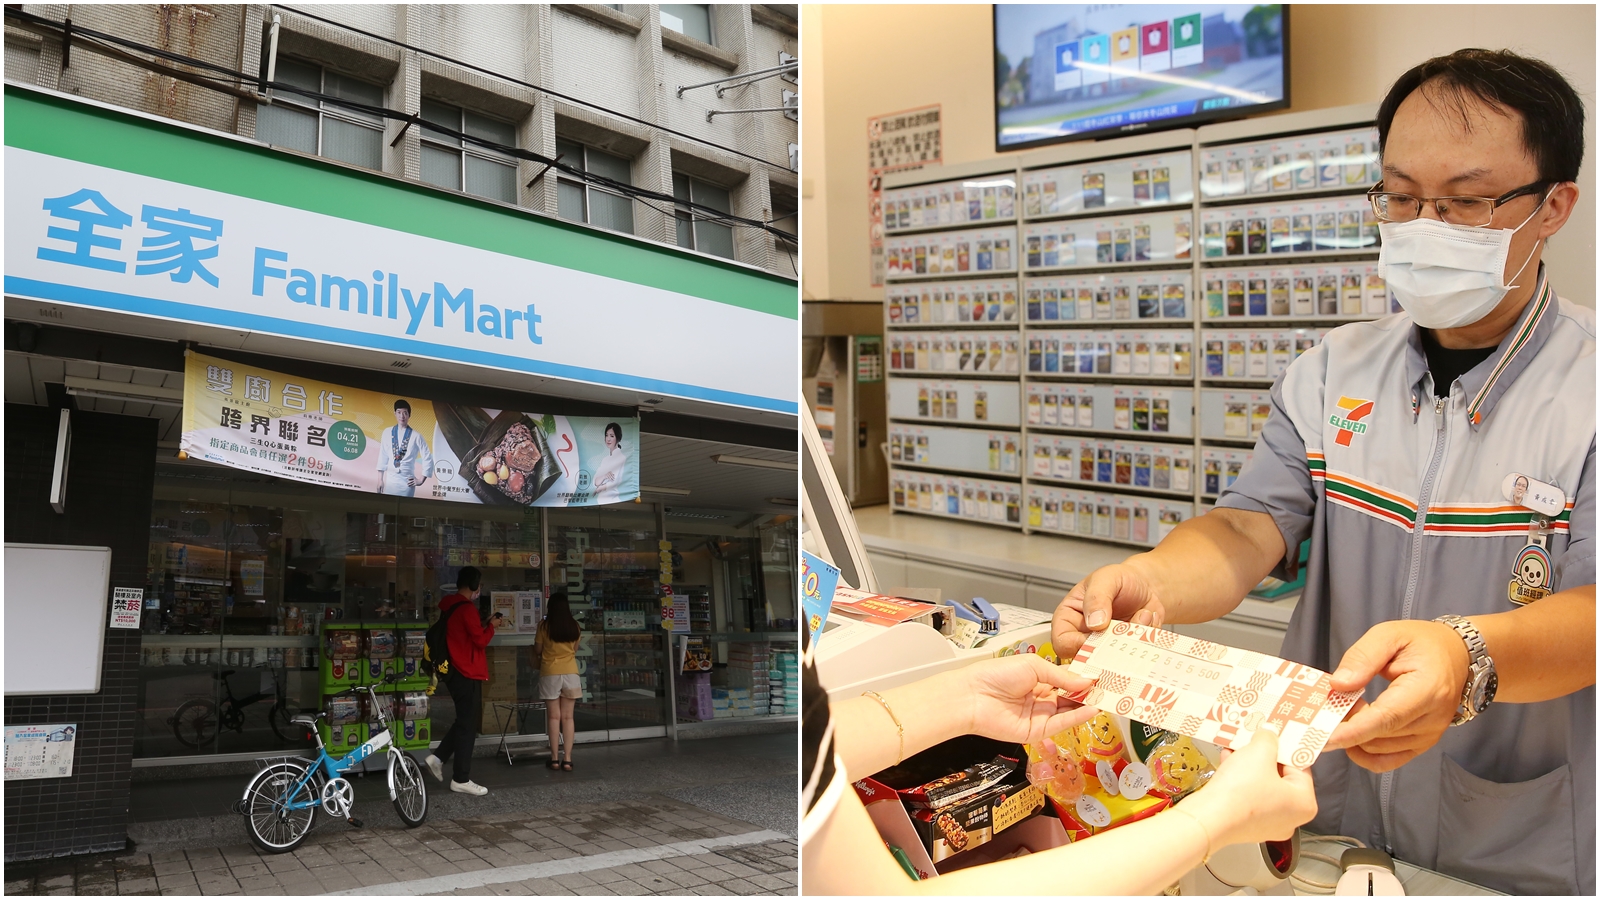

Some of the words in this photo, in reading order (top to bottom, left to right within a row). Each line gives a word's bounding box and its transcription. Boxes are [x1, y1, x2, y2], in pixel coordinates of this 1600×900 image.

[36, 188, 225, 289] 全家
[252, 246, 543, 345] FamilyMart
[206, 365, 343, 416] 雙廚合作
[220, 406, 327, 447] 跨界聯名
[337, 432, 359, 443] 04.21
[1335, 395, 1375, 447] 7
[209, 437, 333, 472] 指定商品會員任選2件95折
[344, 446, 358, 454] 06.08
[114, 599, 140, 612] 禁菸
[1109, 639, 1118, 648] 2
[1119, 643, 1128, 652] 2
[1129, 647, 1138, 656] 2
[1139, 650, 1149, 659] 2
[1150, 654, 1160, 663] 2
[1163, 656, 1173, 666] 5
[1175, 660, 1184, 670] 5
[1185, 665, 1195, 674] 5
[1197, 668, 1221, 681] 500
[1294, 690, 1326, 722] 振興
